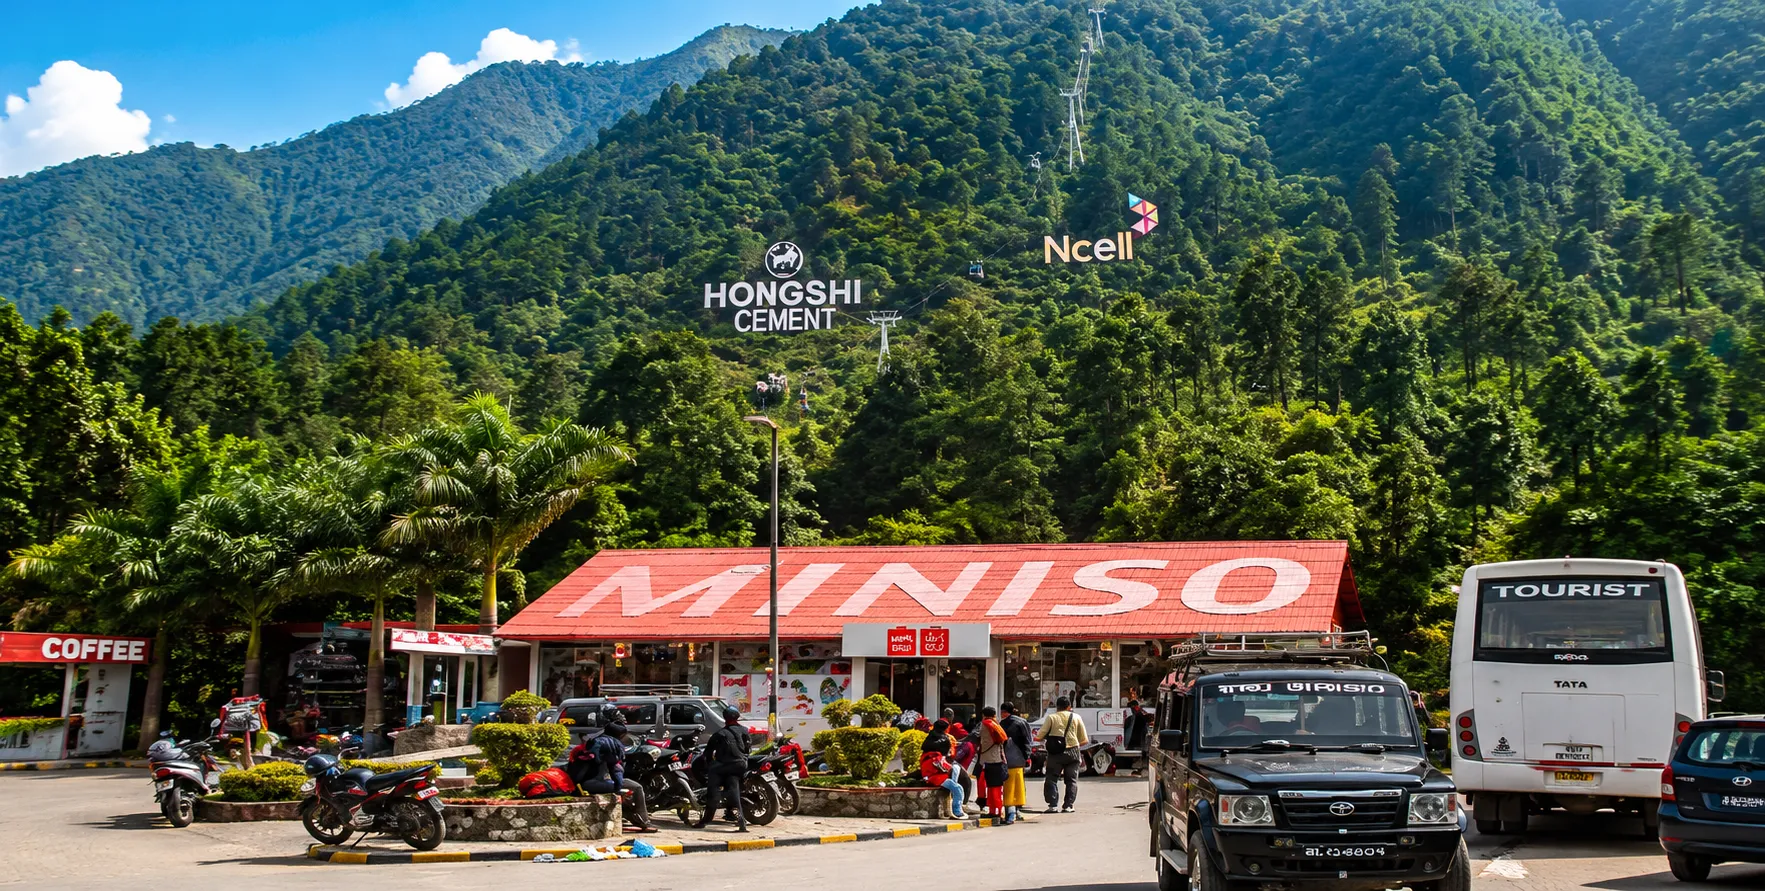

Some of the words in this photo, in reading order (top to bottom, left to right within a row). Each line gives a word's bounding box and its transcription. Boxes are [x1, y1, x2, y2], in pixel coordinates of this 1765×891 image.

[1044, 231, 1134, 264] Ncell
[703, 279, 862, 308] HONGSHI
[734, 307, 836, 333] CEMENT
[556, 558, 1311, 618] MINISO
[1492, 583, 1650, 598] TOURIST
[42, 637, 145, 661] COFFEE
[1554, 680, 1588, 689] TATA
